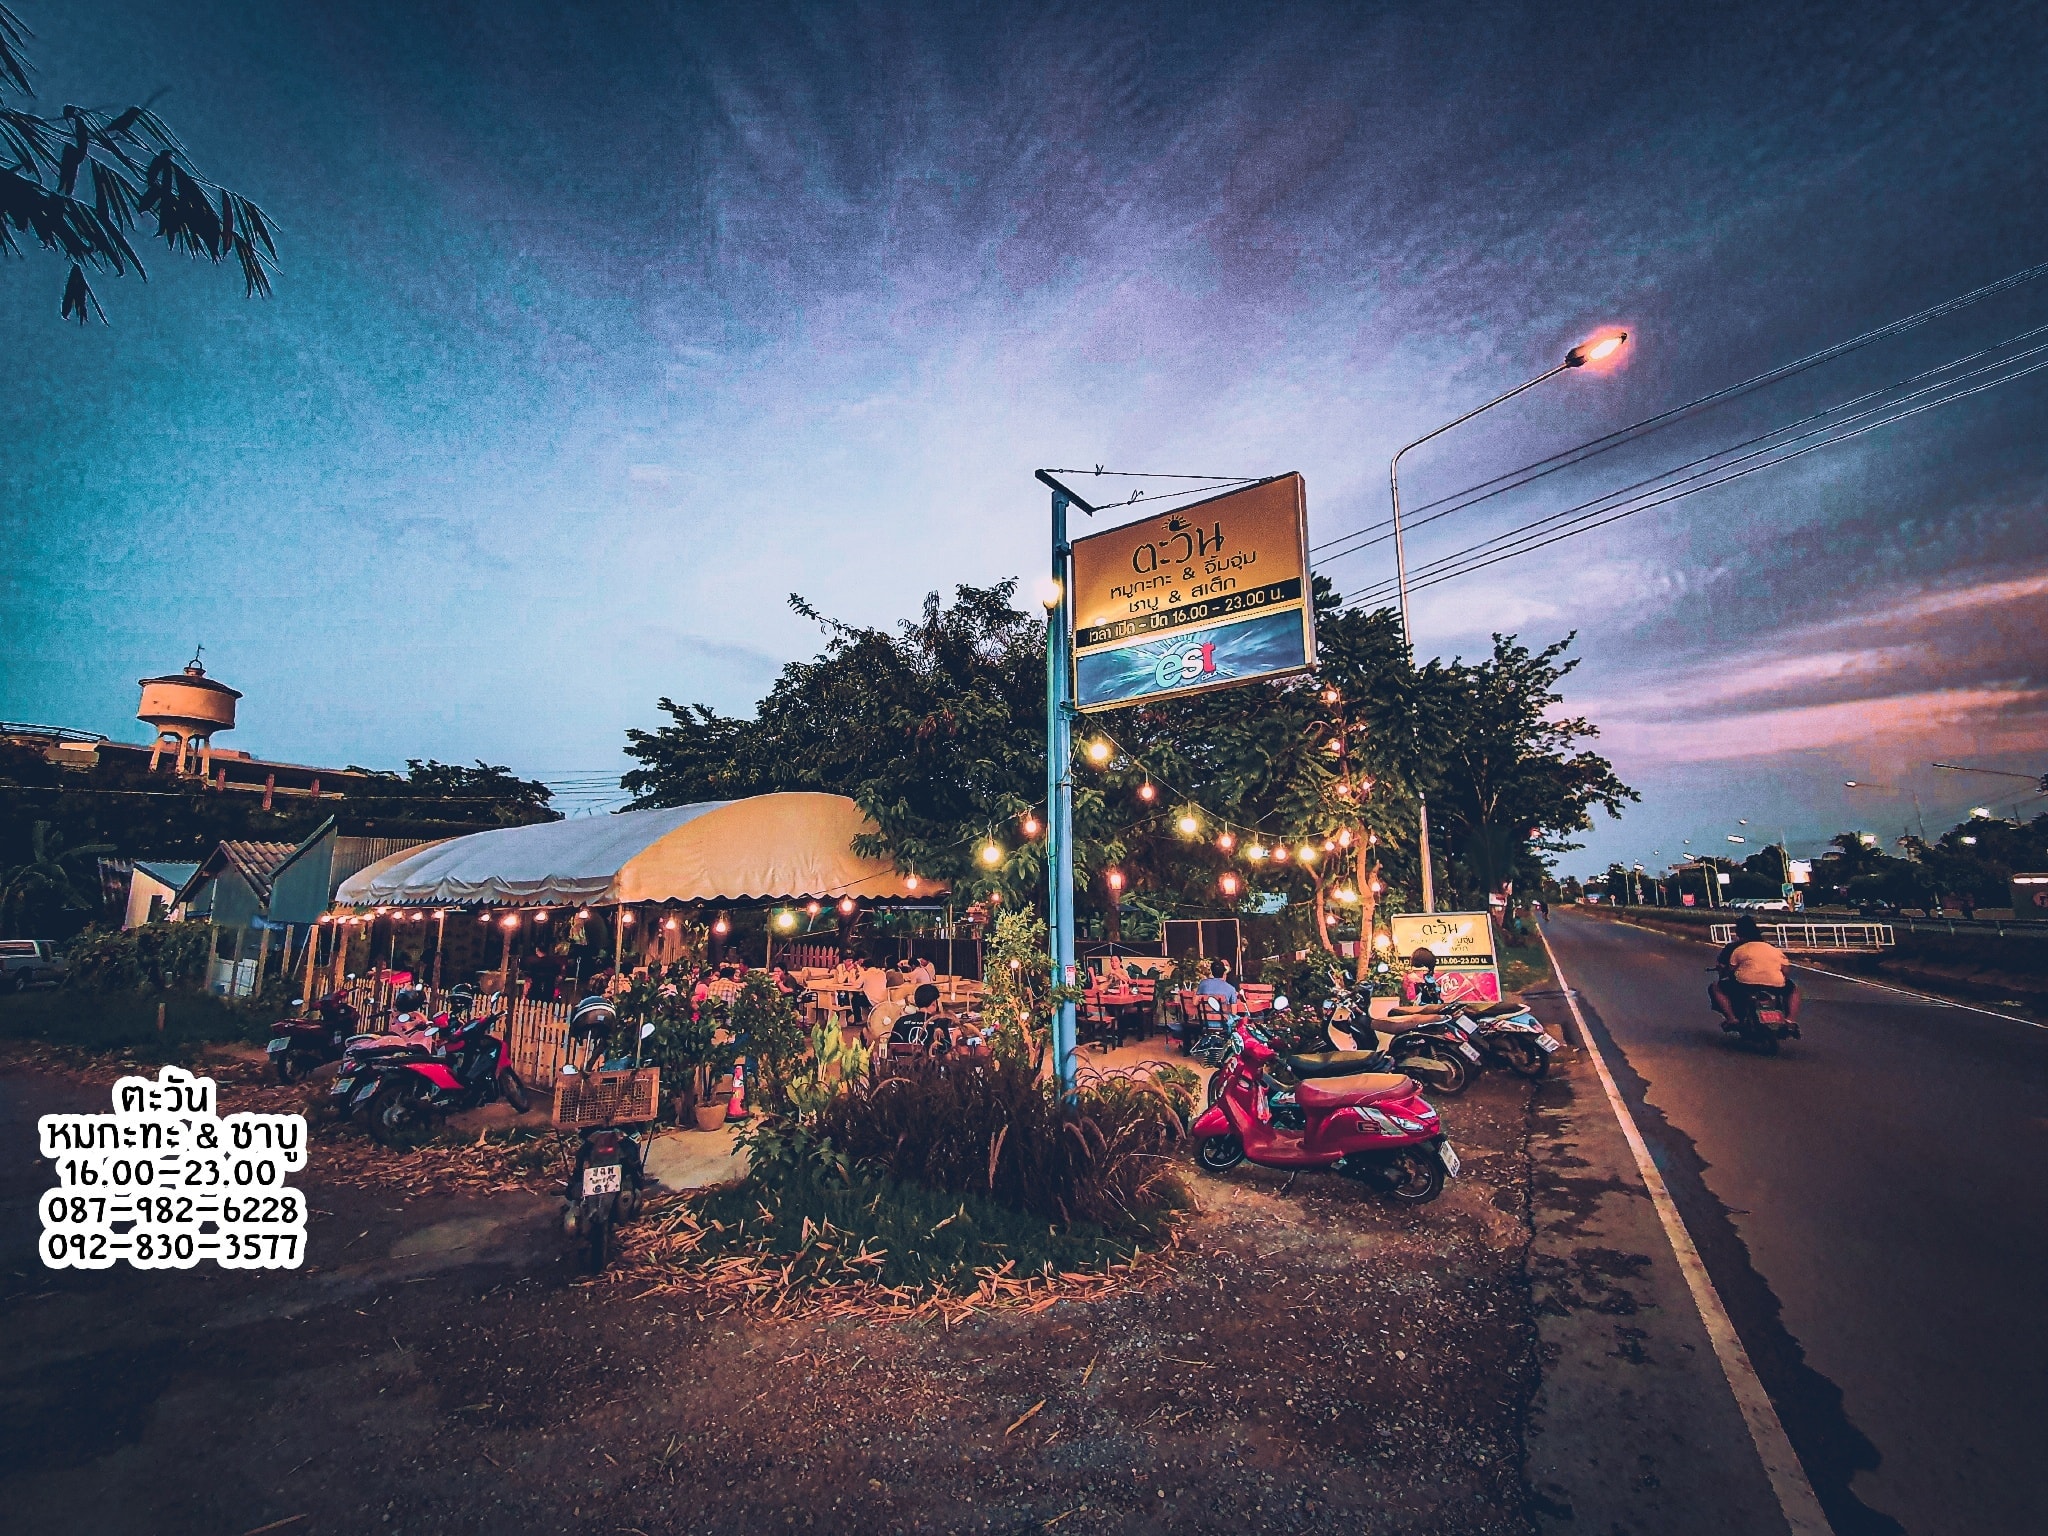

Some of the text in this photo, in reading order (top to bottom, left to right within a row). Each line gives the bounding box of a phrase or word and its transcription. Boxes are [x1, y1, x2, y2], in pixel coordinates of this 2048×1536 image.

[1132, 517, 1225, 574] ตะวัน
[1110, 550, 1257, 599] หมูกะทะ & จิ้มจุ่ม
[1129, 575, 1236, 613] ชาบู & สเต็ก
[1089, 628, 1112, 643] เวลา
[1115, 620, 1136, 637] เปิด
[1150, 611, 1168, 629] ปิด
[1172, 604, 1208, 624] 16.00
[1225, 590, 1265, 612] 23.00
[1270, 587, 1285, 600] น.
[1155, 642, 1217, 688] est
